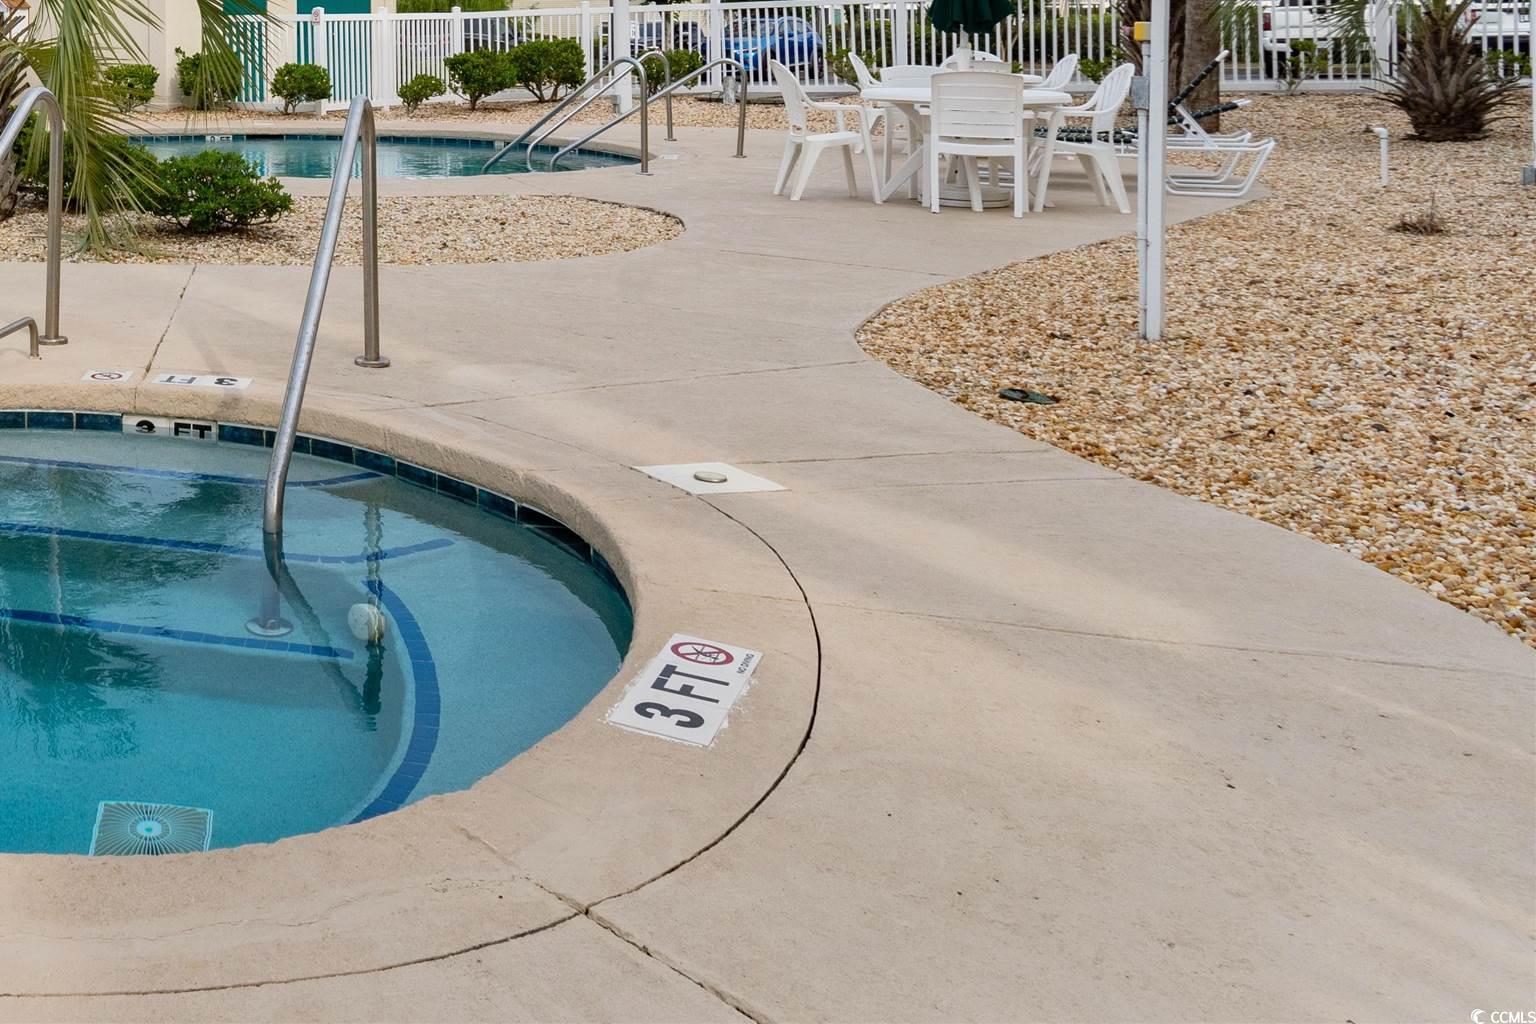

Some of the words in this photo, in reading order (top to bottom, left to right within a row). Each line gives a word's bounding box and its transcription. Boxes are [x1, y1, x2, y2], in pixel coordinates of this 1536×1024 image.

[174, 422, 213, 439] FT
[650, 664, 730, 704] FT
[634, 701, 705, 729] 3
